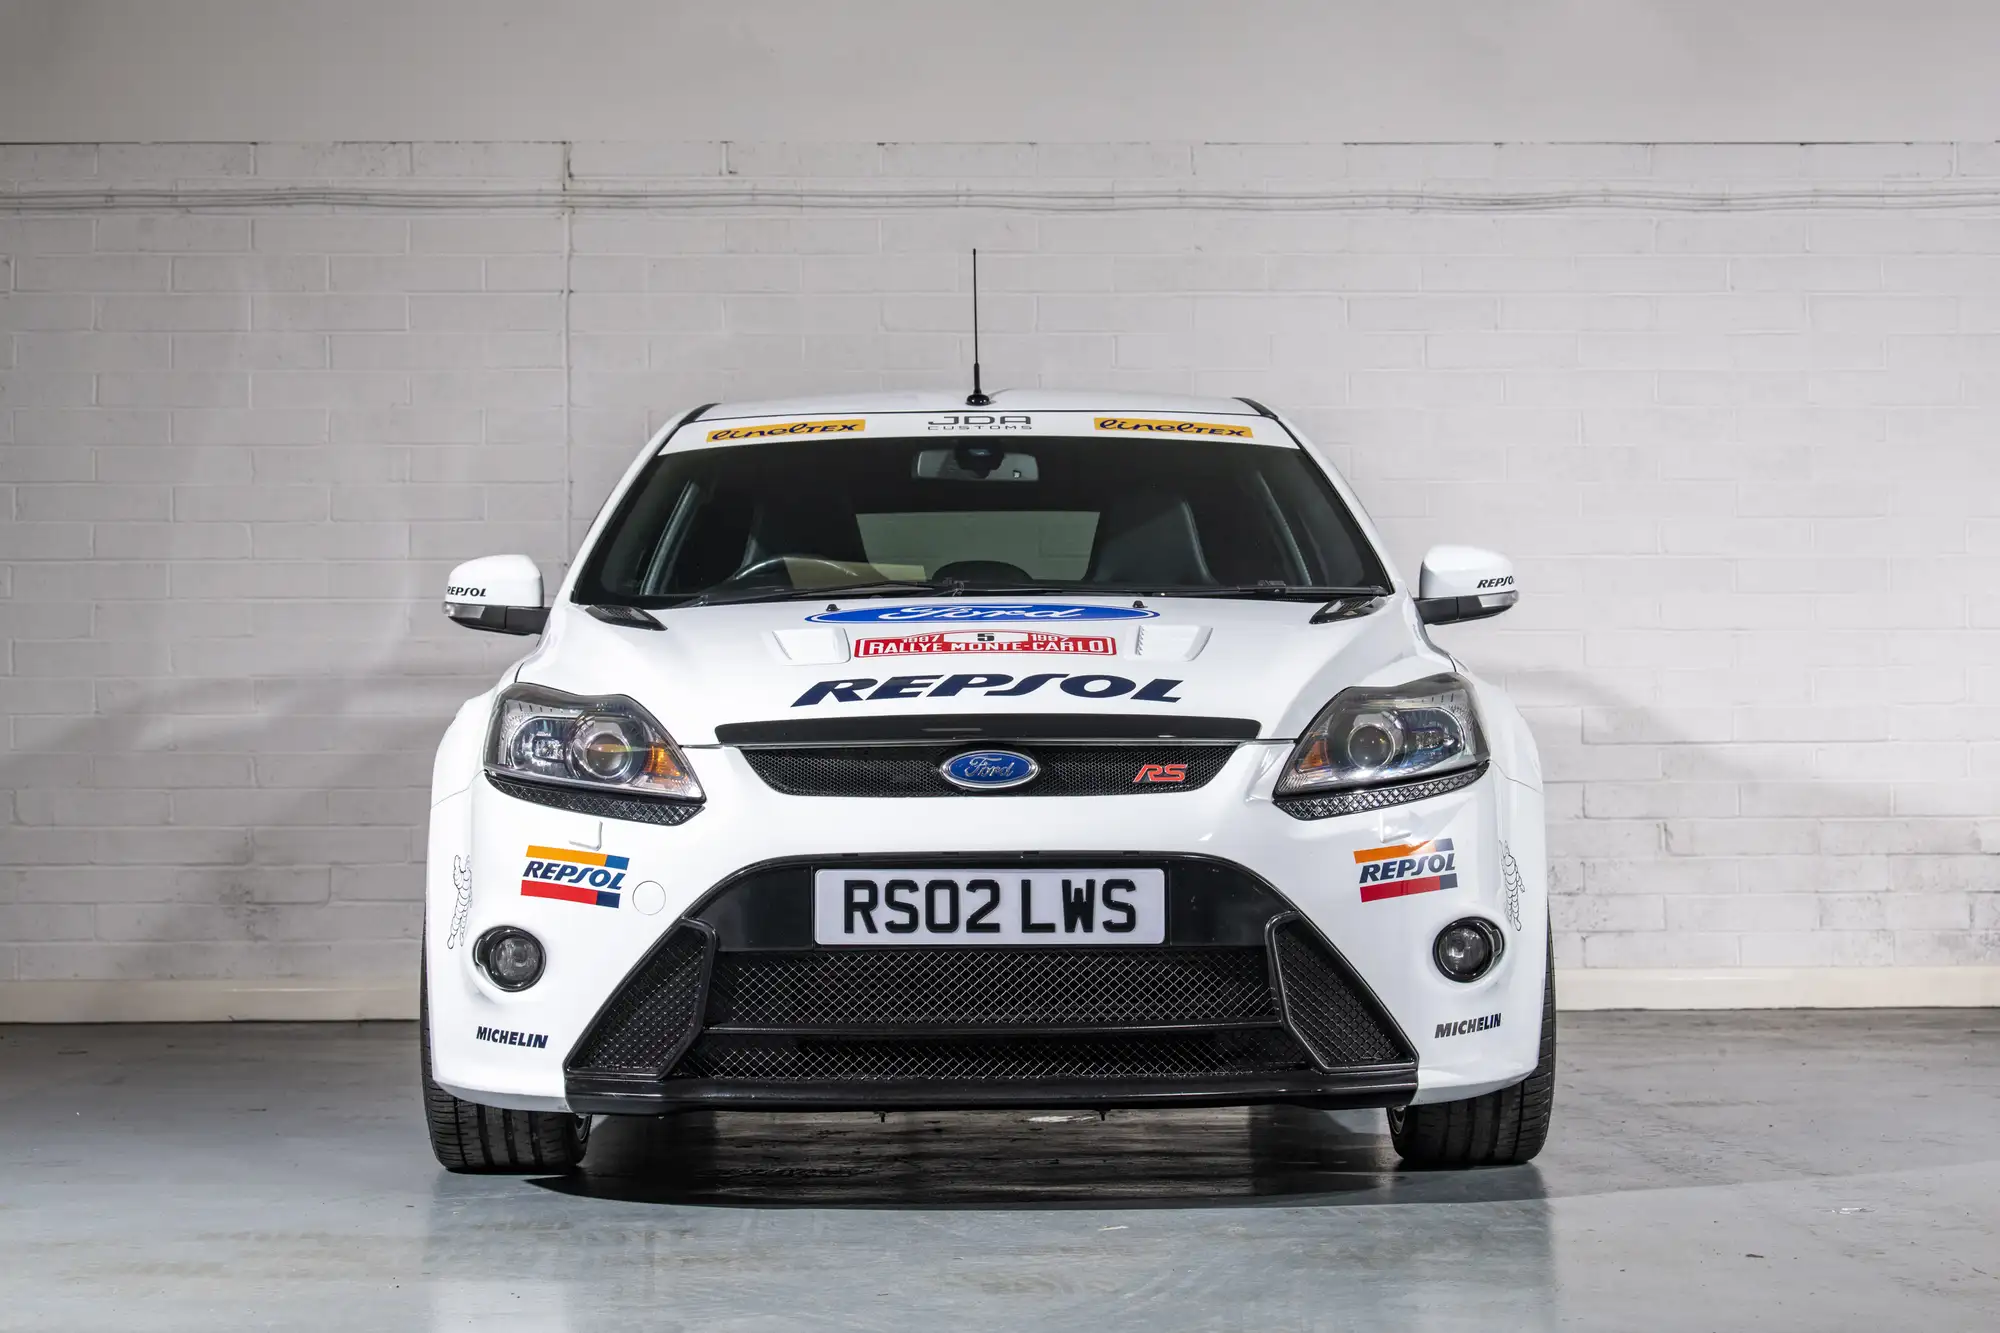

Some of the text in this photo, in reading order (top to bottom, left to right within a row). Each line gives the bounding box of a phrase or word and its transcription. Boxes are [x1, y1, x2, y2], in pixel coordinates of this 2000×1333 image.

[927, 415, 1032, 425] JDA
[1476, 575, 1515, 589] REPSO
[878, 605, 1085, 620] Ford
[868, 640, 1104, 654] RALLYE MONTE-CARLO
[977, 633, 994, 642] 5
[790, 673, 1184, 708] REPSOL
[964, 756, 1015, 778] Ford
[1132, 763, 1188, 783] RS
[522, 860, 626, 890] REPSOL
[1358, 853, 1456, 884] REPSOL
[843, 878, 1137, 934] RS02 LWS
[1434, 1013, 1502, 1039] MICHELIN
[475, 1026, 549, 1049] MICHELIN
